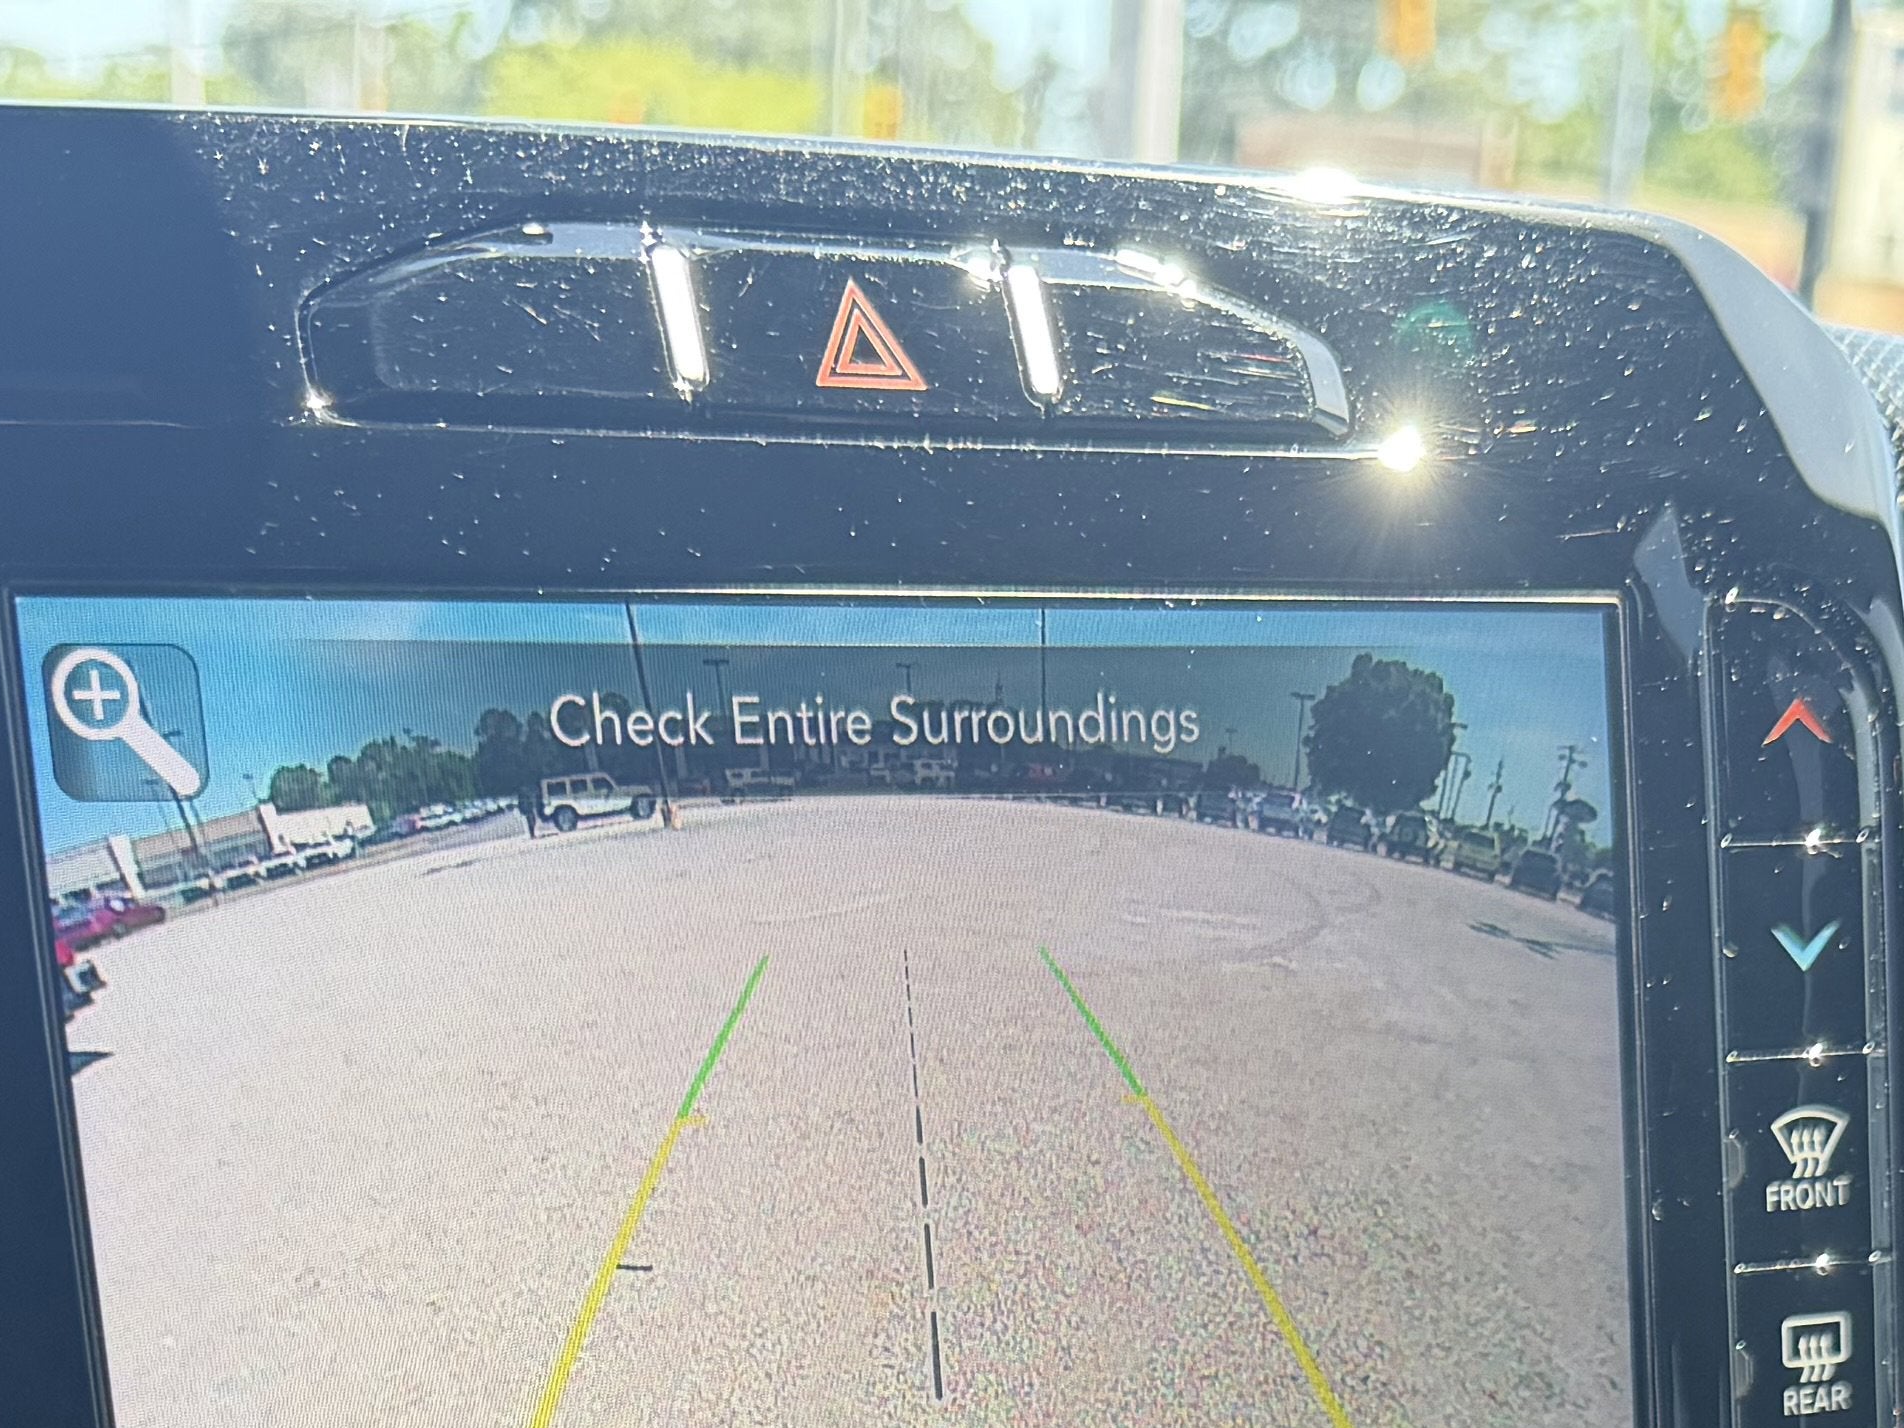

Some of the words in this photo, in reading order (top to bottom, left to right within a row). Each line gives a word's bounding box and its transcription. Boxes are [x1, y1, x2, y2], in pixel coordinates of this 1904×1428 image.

[549, 690, 710, 748] Check
[731, 695, 872, 747] Entire
[889, 690, 1200, 753] Surroundings
[1766, 1174, 1851, 1212] FRONT
[1783, 1383, 1851, 1416] REAR
